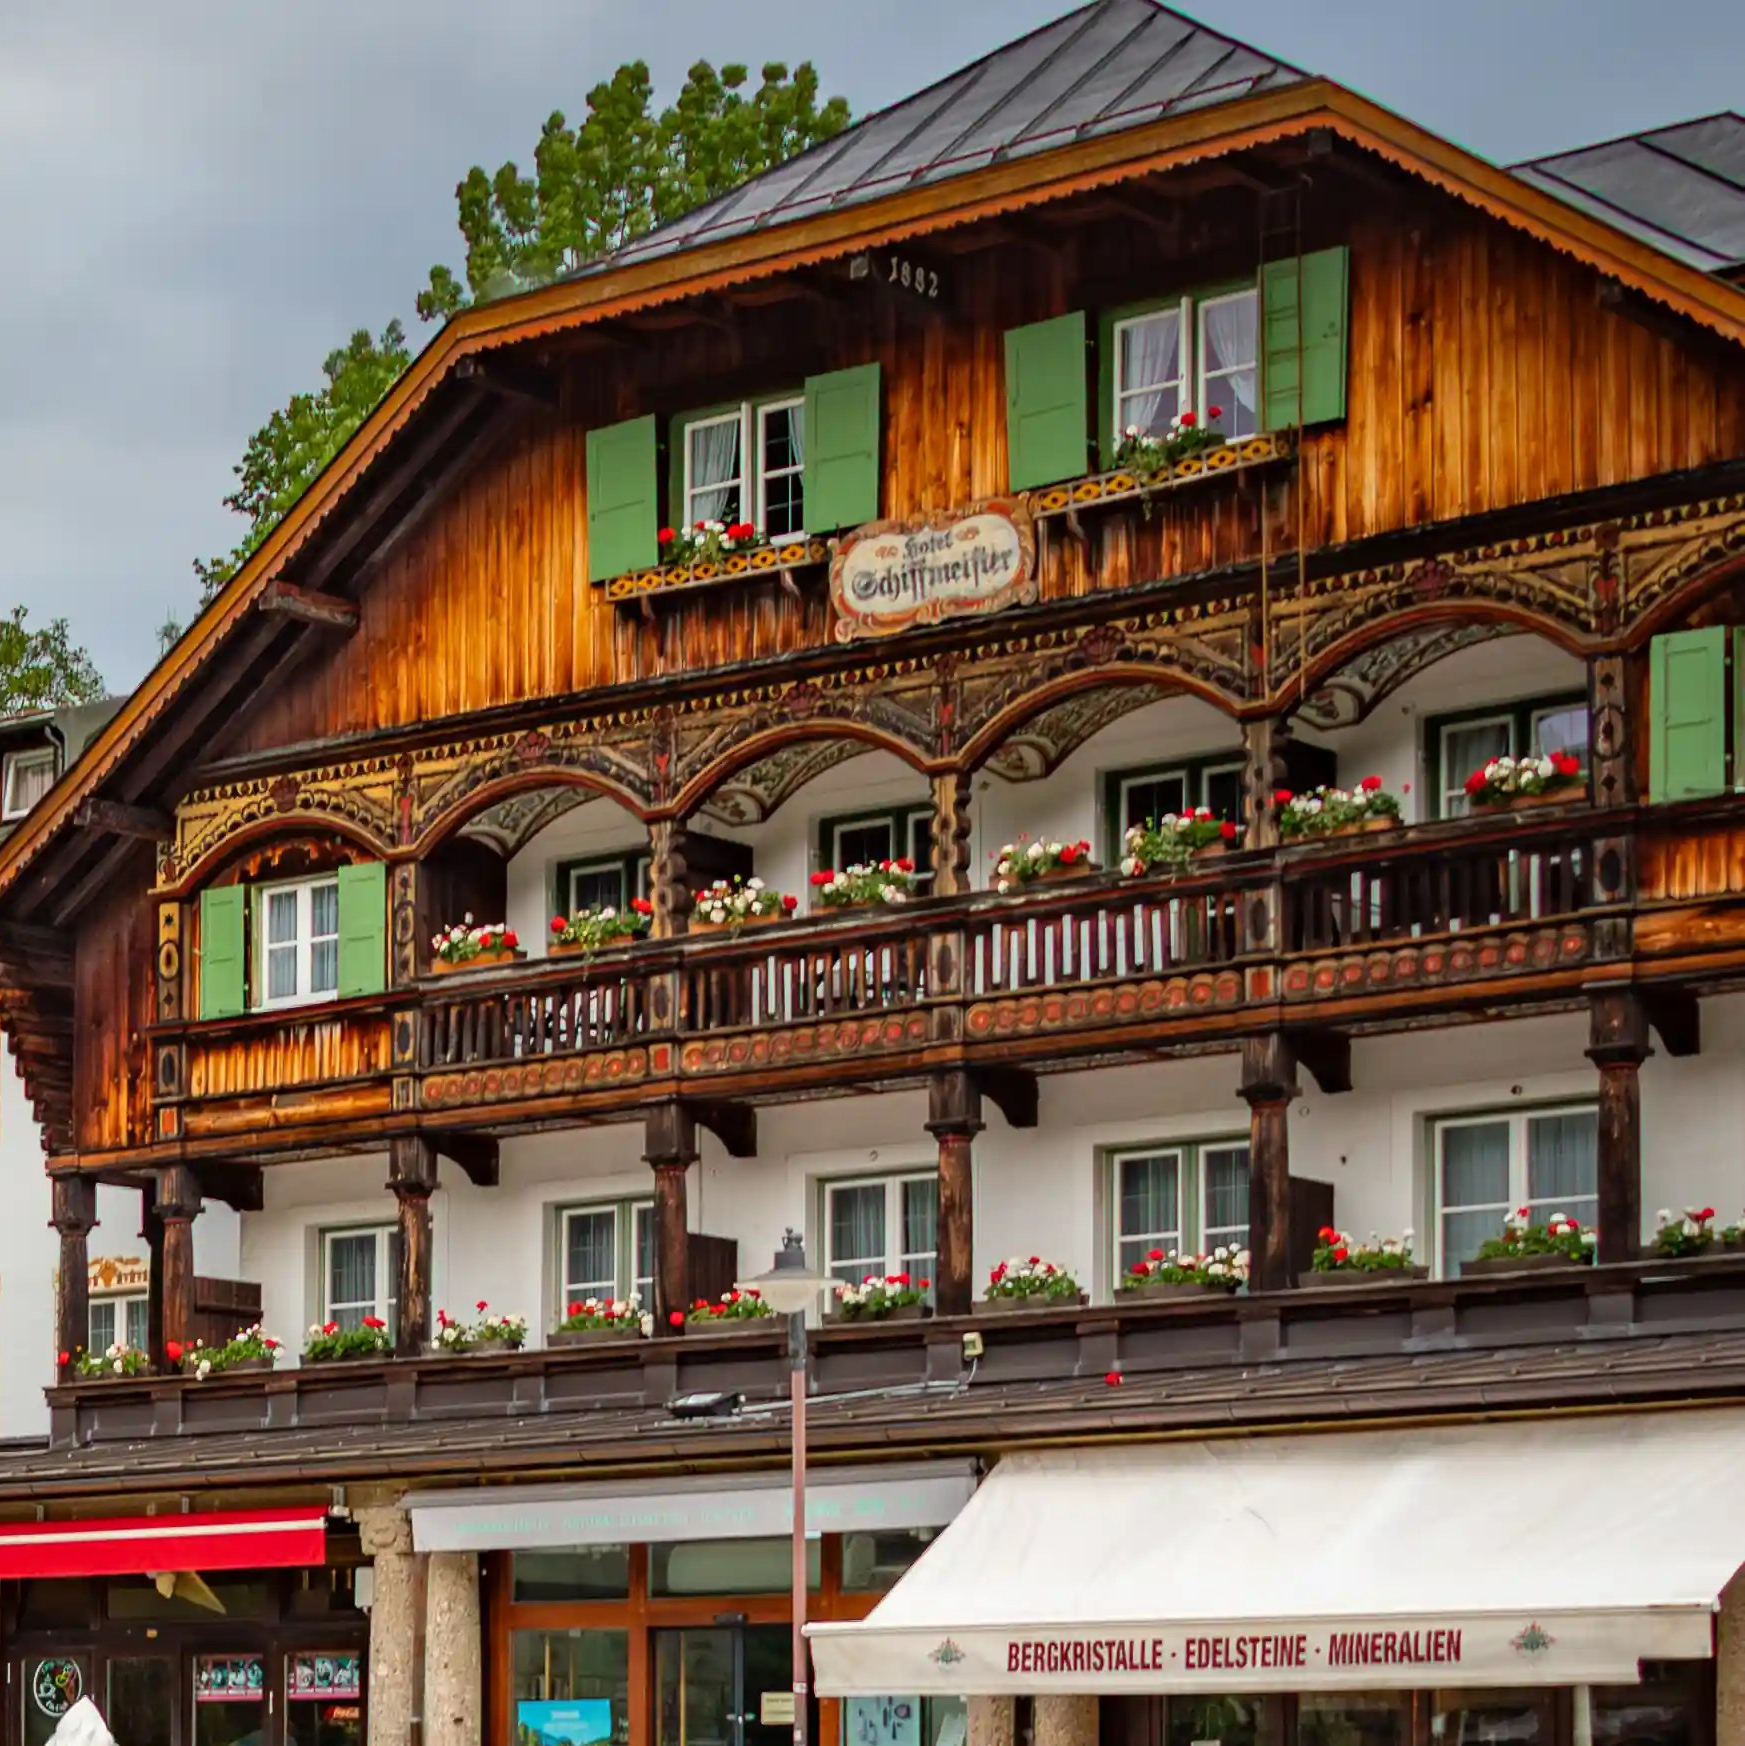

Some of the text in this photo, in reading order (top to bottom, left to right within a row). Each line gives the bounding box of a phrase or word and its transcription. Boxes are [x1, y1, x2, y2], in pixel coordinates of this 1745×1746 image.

[888, 256, 938, 298] 1882
[904, 528, 954, 561] Hotel
[1007, 1629, 1462, 1673] BERGKRISTALLE EDELSTEINE MINERALIEN
